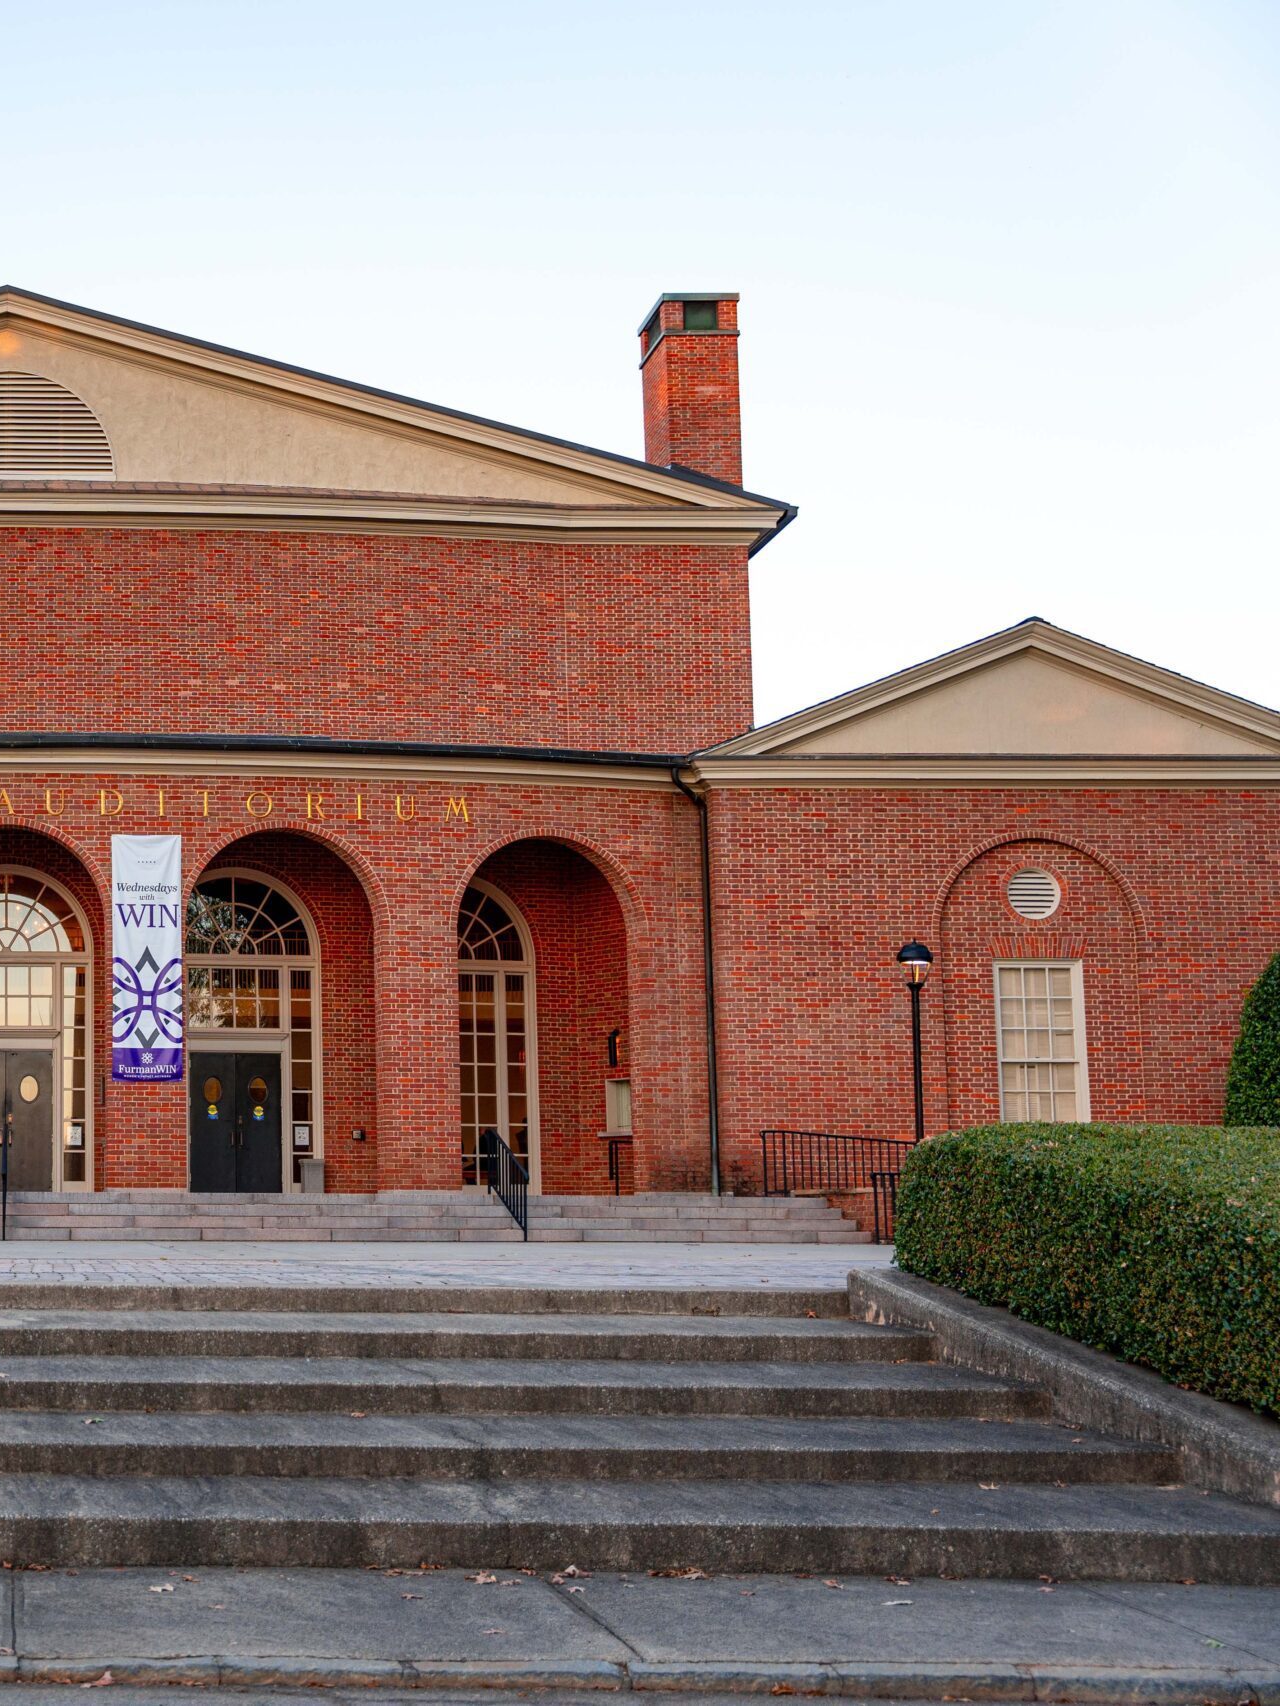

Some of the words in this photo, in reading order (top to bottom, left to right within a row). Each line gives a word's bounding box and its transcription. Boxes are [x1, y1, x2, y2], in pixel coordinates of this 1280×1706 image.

[117, 882, 178, 894] Wednesdays
[115, 903, 180, 928] WIN
[118, 1064, 177, 1074] FurmanWIN
